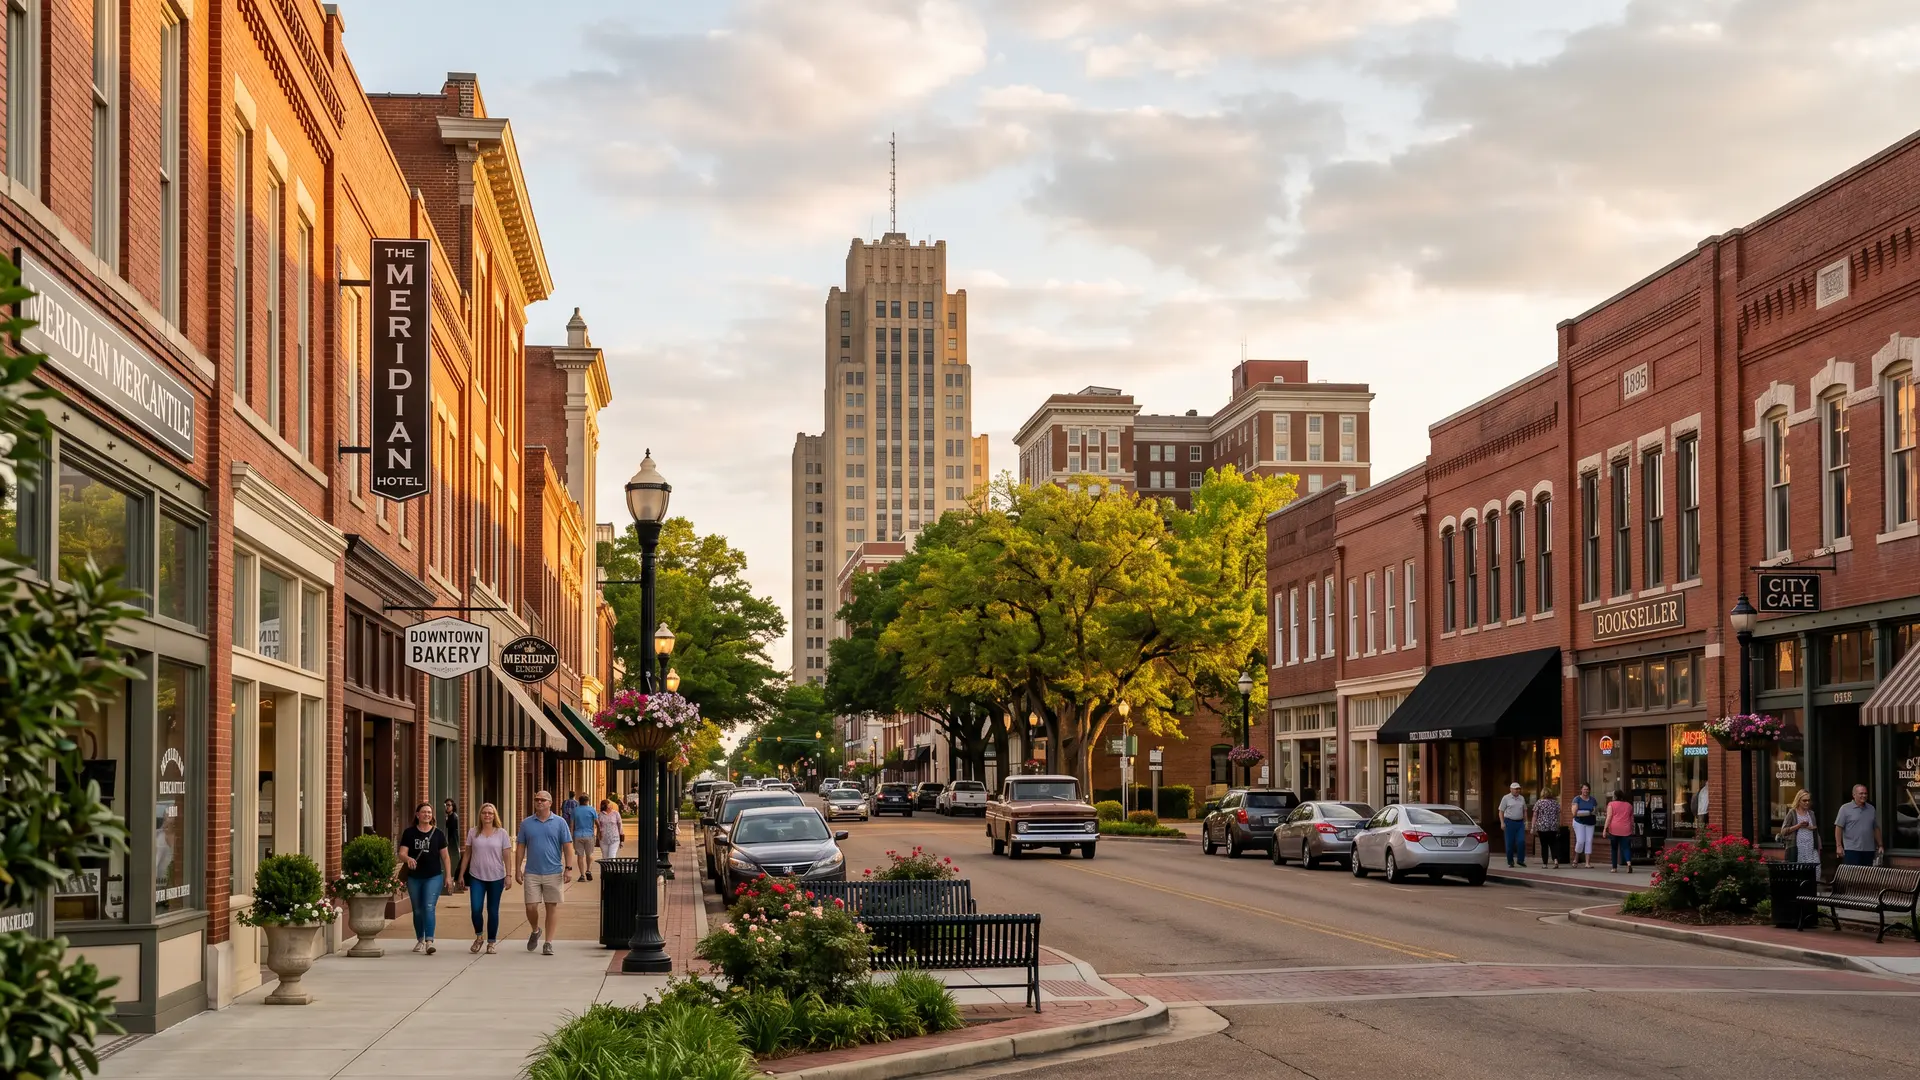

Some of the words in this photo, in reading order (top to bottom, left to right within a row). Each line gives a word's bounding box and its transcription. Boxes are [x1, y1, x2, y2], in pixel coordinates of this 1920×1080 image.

[385, 248, 415, 258] THE
[29, 282, 109, 381] MERIDIAN
[112, 348, 191, 441] MERCANTILE
[386, 263, 414, 469] MERIDIAN
[1625, 367, 1647, 395] 1895
[377, 476, 423, 486] HOTEL
[1769, 578, 1810, 592] CITY
[1766, 593, 1815, 607] CAFE
[1597, 600, 1678, 635] BOOKSELLER
[410, 630, 483, 643] DOWNTOWN
[412, 646, 481, 663] BAKERY
